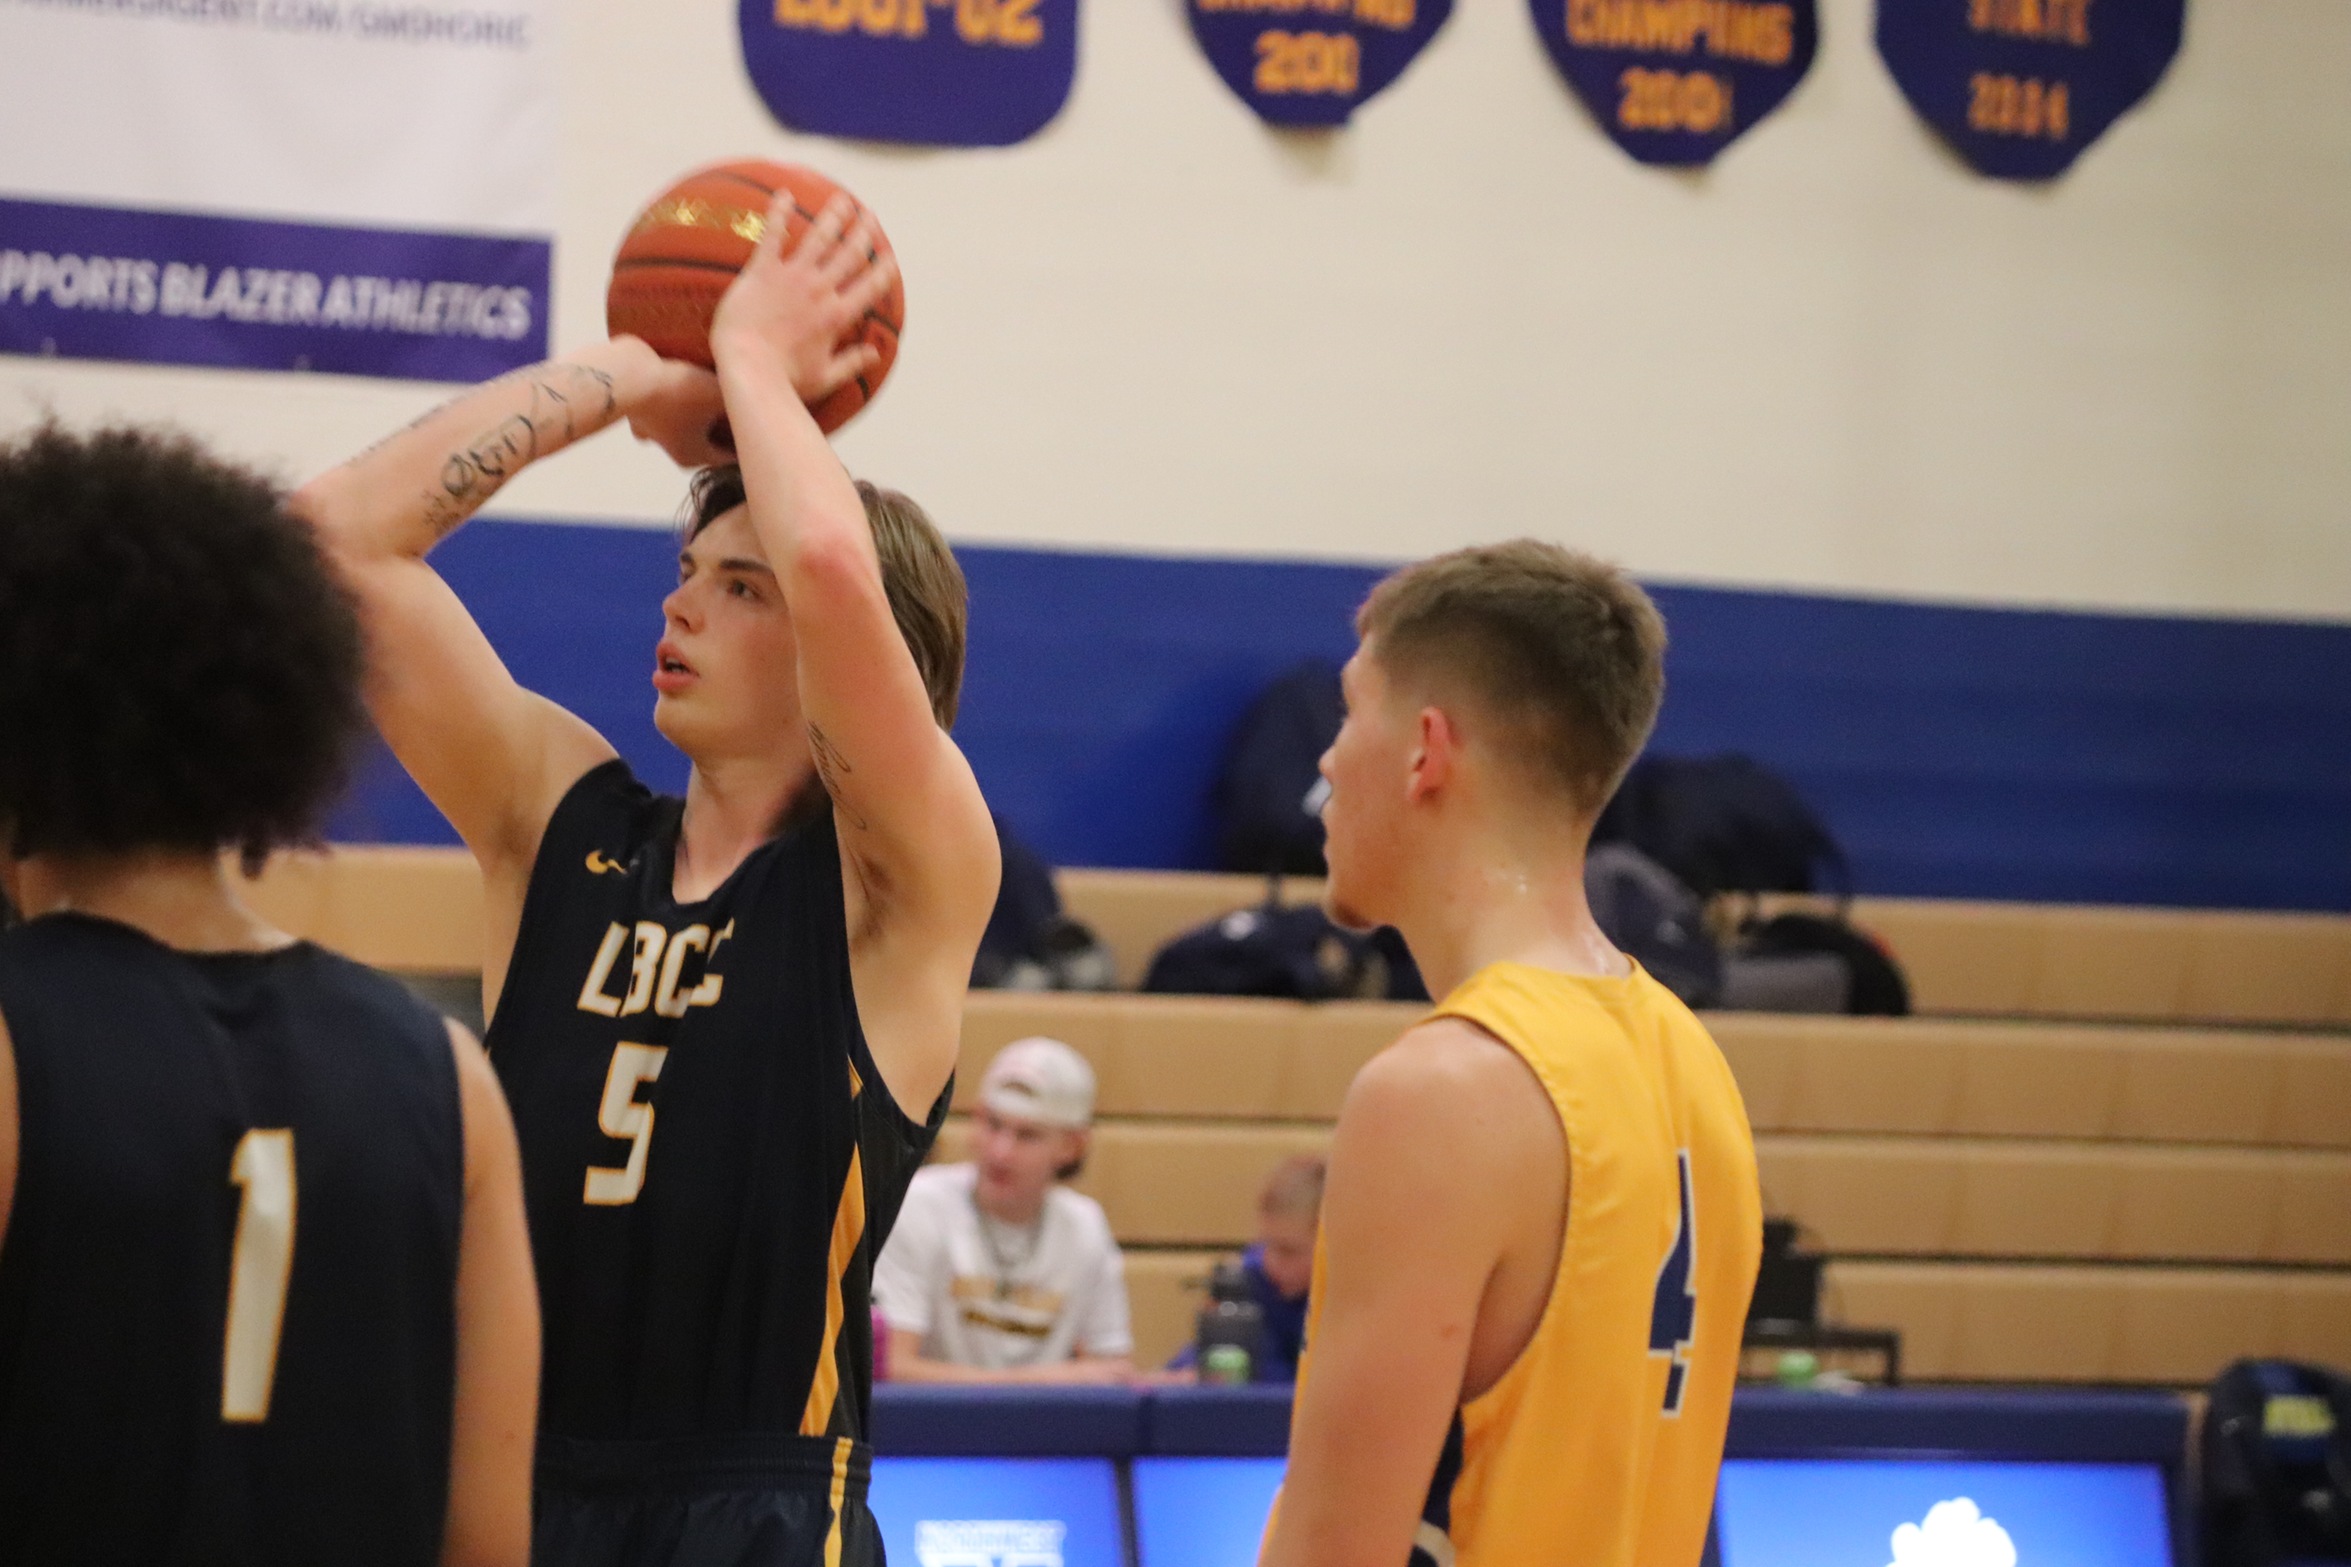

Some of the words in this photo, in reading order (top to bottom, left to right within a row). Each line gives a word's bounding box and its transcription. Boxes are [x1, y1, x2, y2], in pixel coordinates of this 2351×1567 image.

[160, 262, 322, 326] BLAZER
[322, 275, 531, 340] ATHLETICS
[583, 1041, 669, 1206] 5
[220, 1127, 297, 1424] 1
